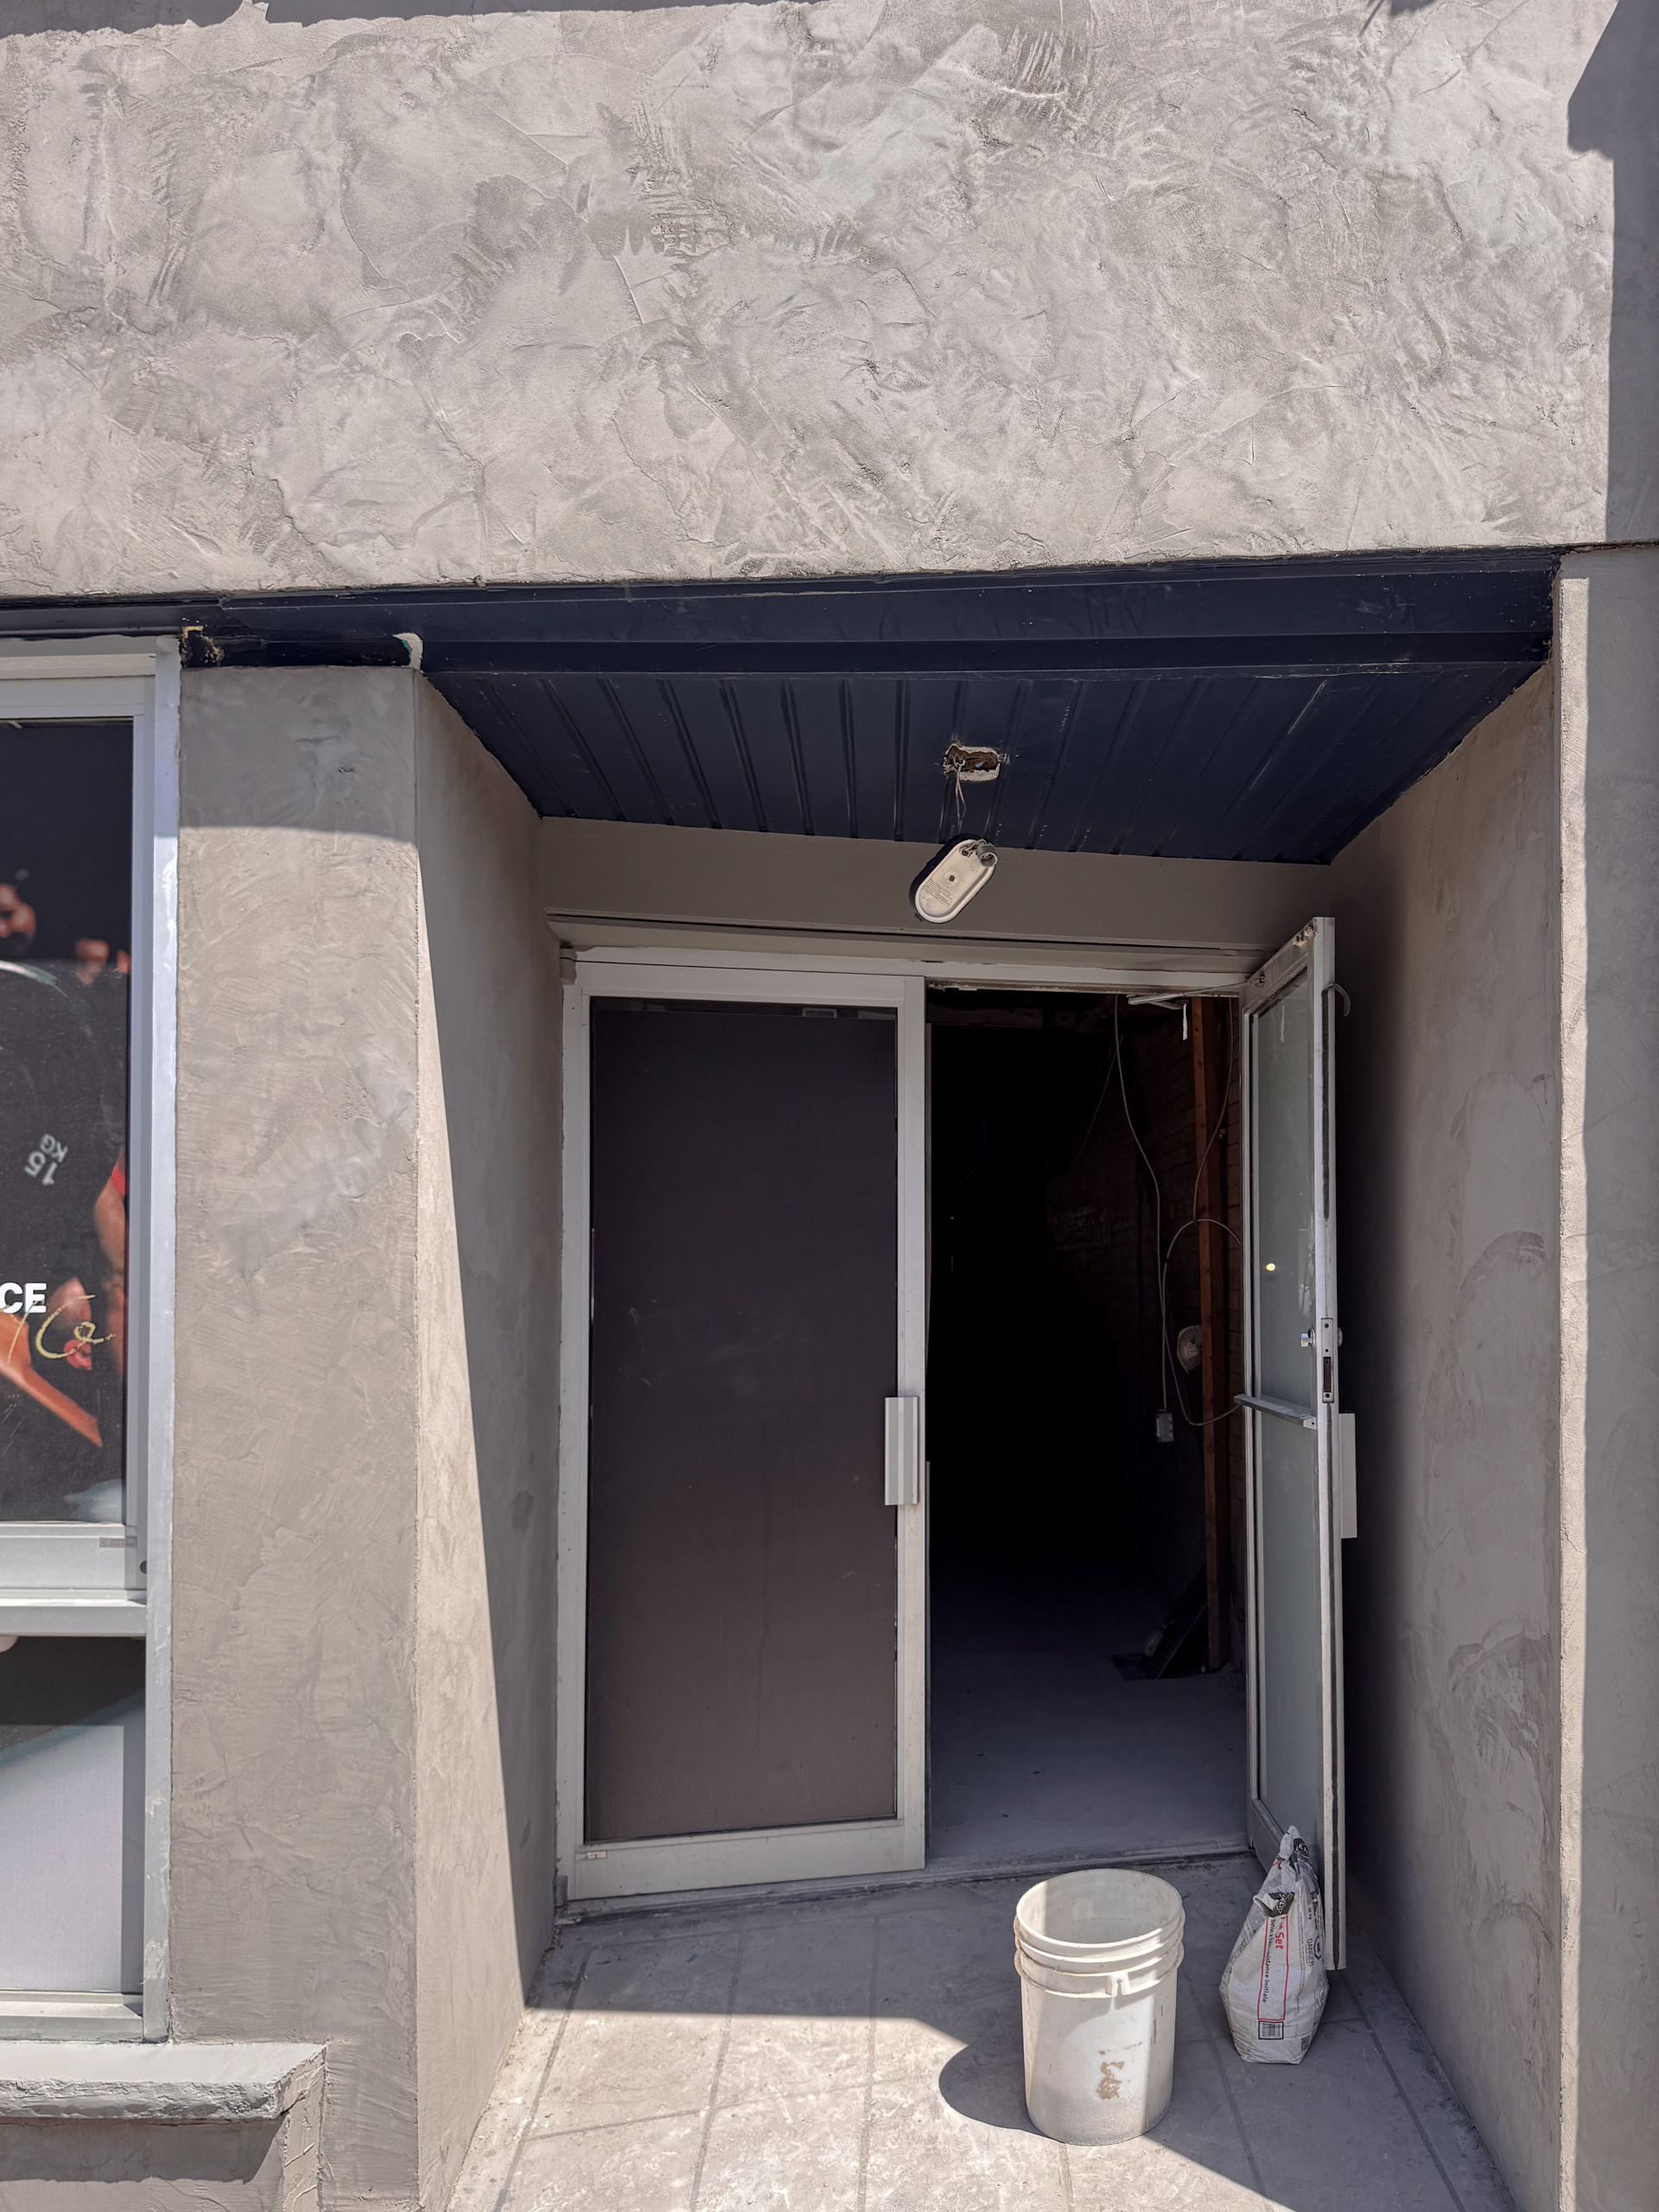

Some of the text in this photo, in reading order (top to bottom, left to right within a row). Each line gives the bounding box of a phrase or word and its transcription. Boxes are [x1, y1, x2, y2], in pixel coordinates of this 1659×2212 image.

[40, 1134, 68, 1162] KG
[24, 1150, 57, 1185] 15
[0, 1282, 47, 1313] CE
[1275, 1932, 1284, 1949] Set
